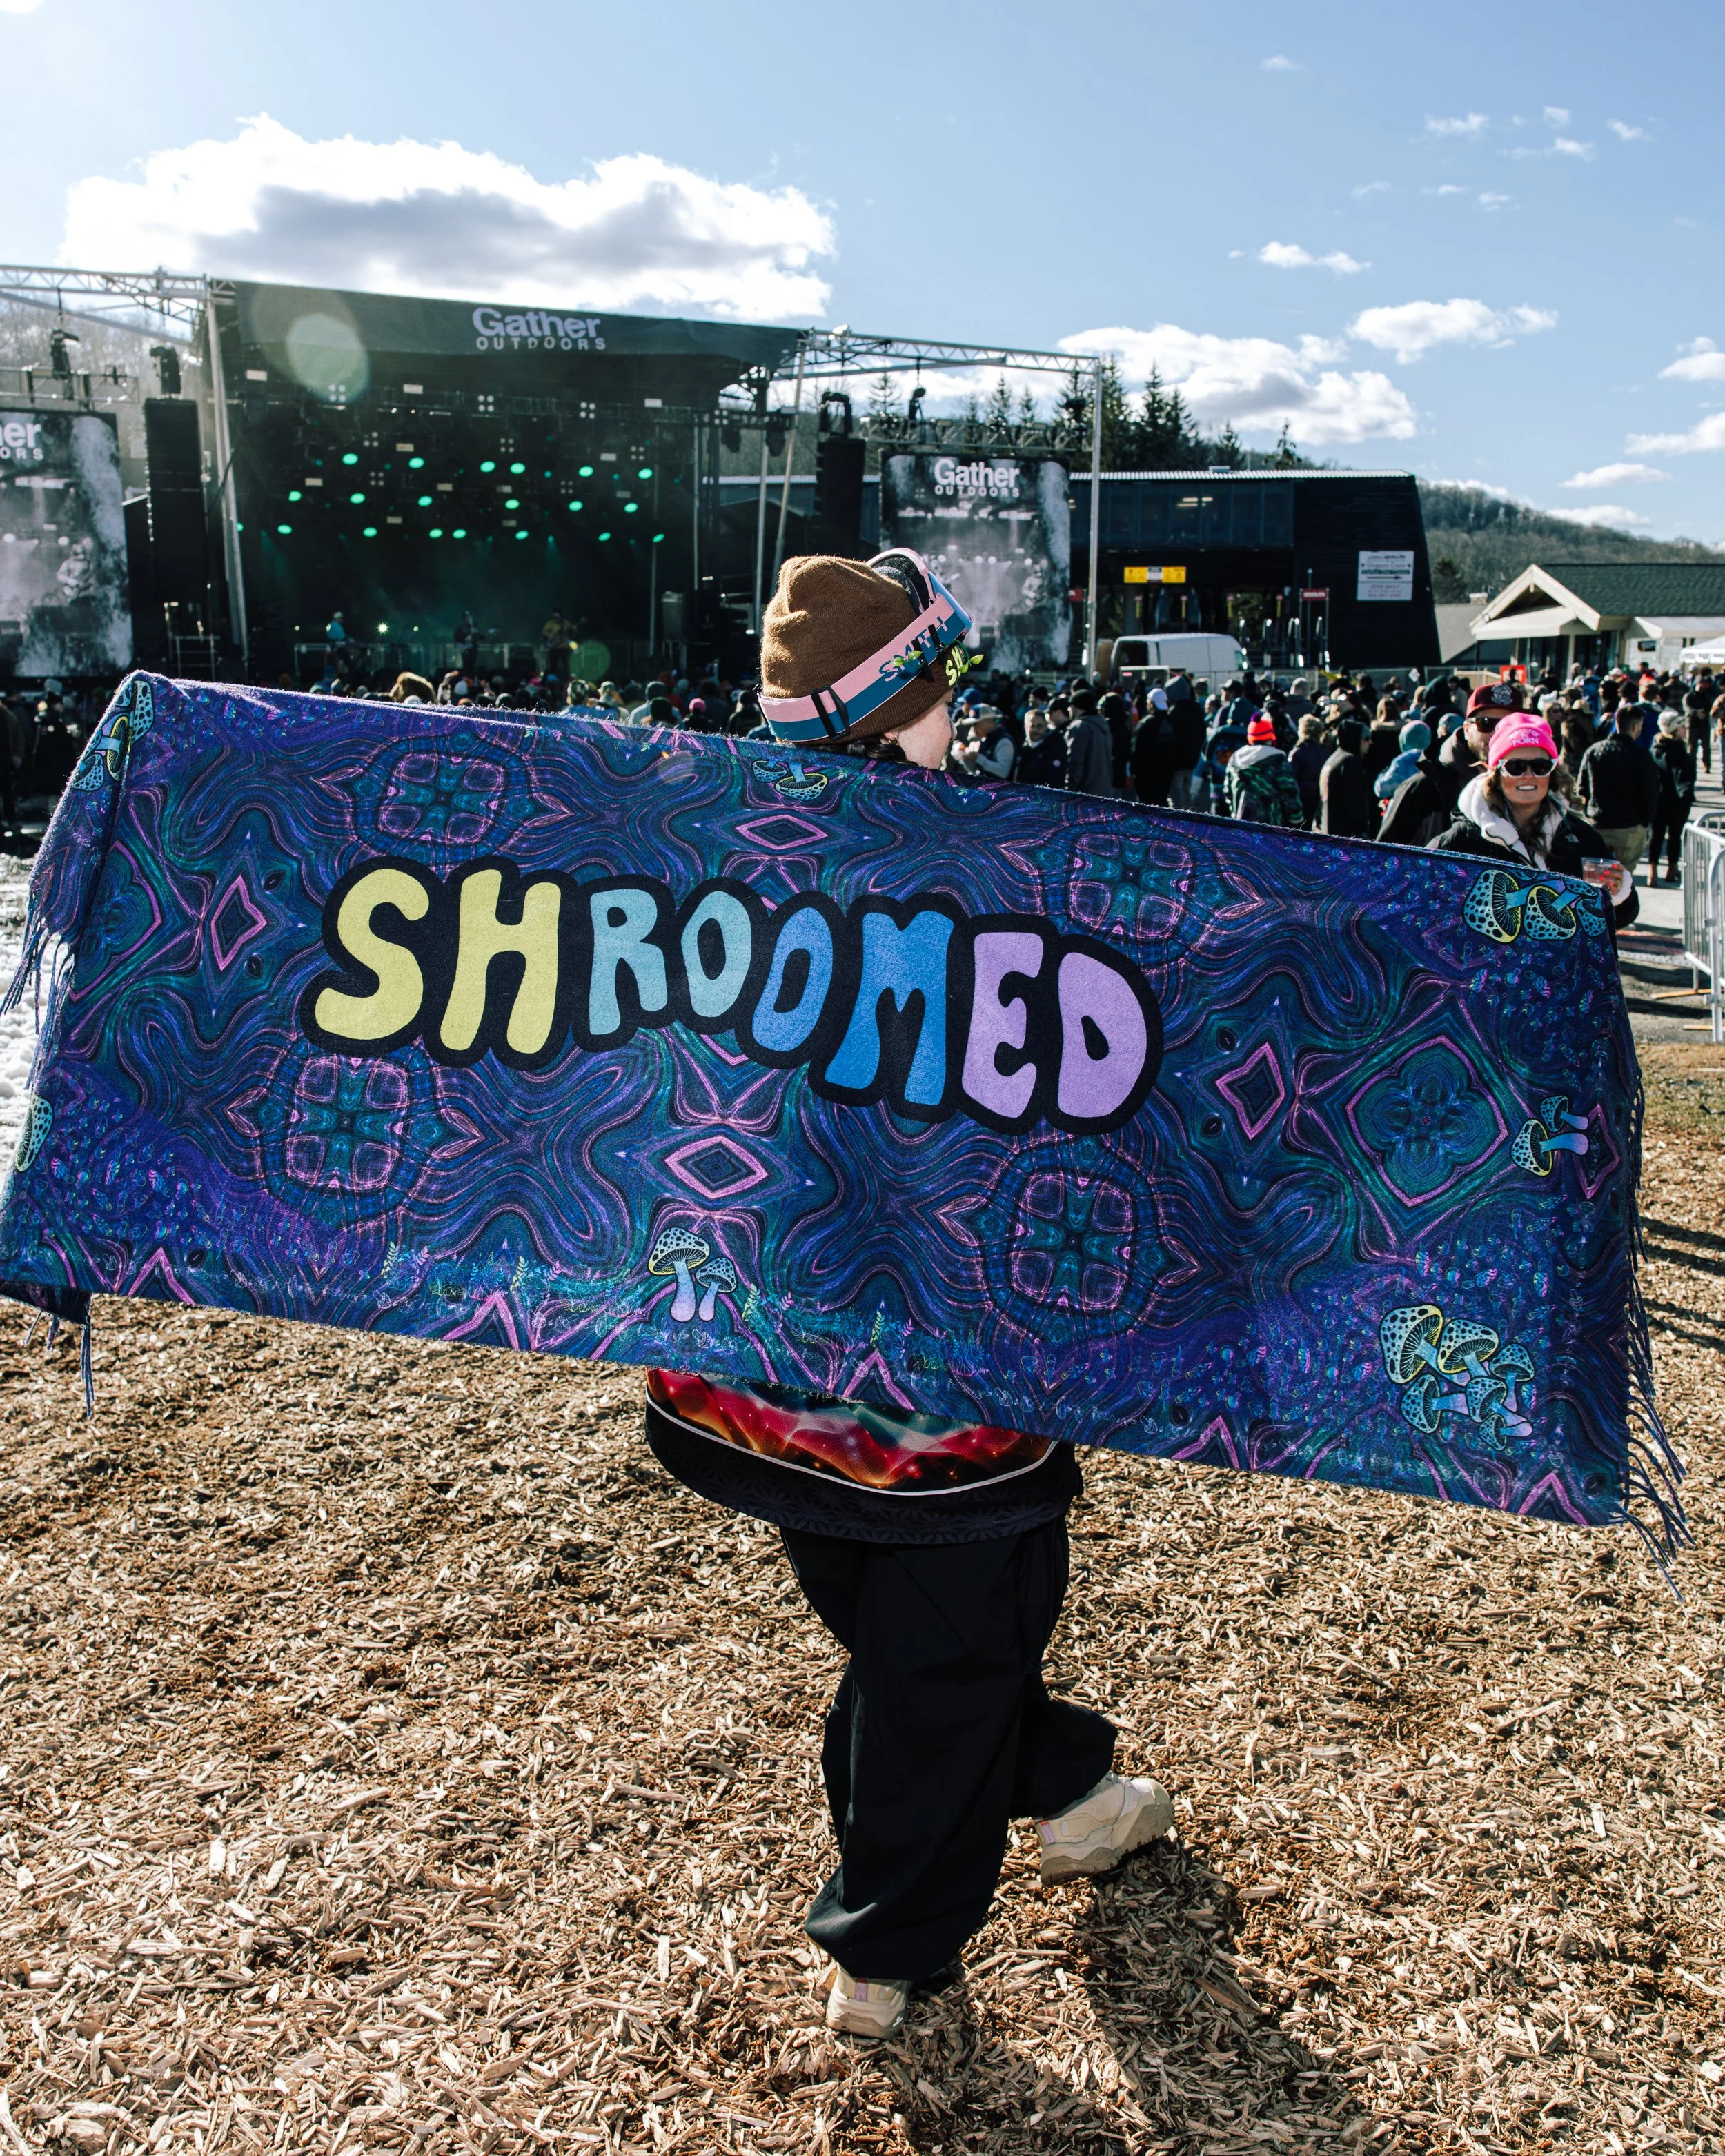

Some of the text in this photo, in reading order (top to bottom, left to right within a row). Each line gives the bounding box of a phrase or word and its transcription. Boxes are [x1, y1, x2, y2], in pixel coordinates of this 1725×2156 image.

[472, 307, 601, 339] Gather
[475, 336, 606, 350] OUTDOORS
[934, 458, 1020, 488] Gather
[934, 484, 1020, 497] OUTDOORS
[878, 616, 948, 682] SMTH
[315, 867, 1147, 1118] SHROOMED
